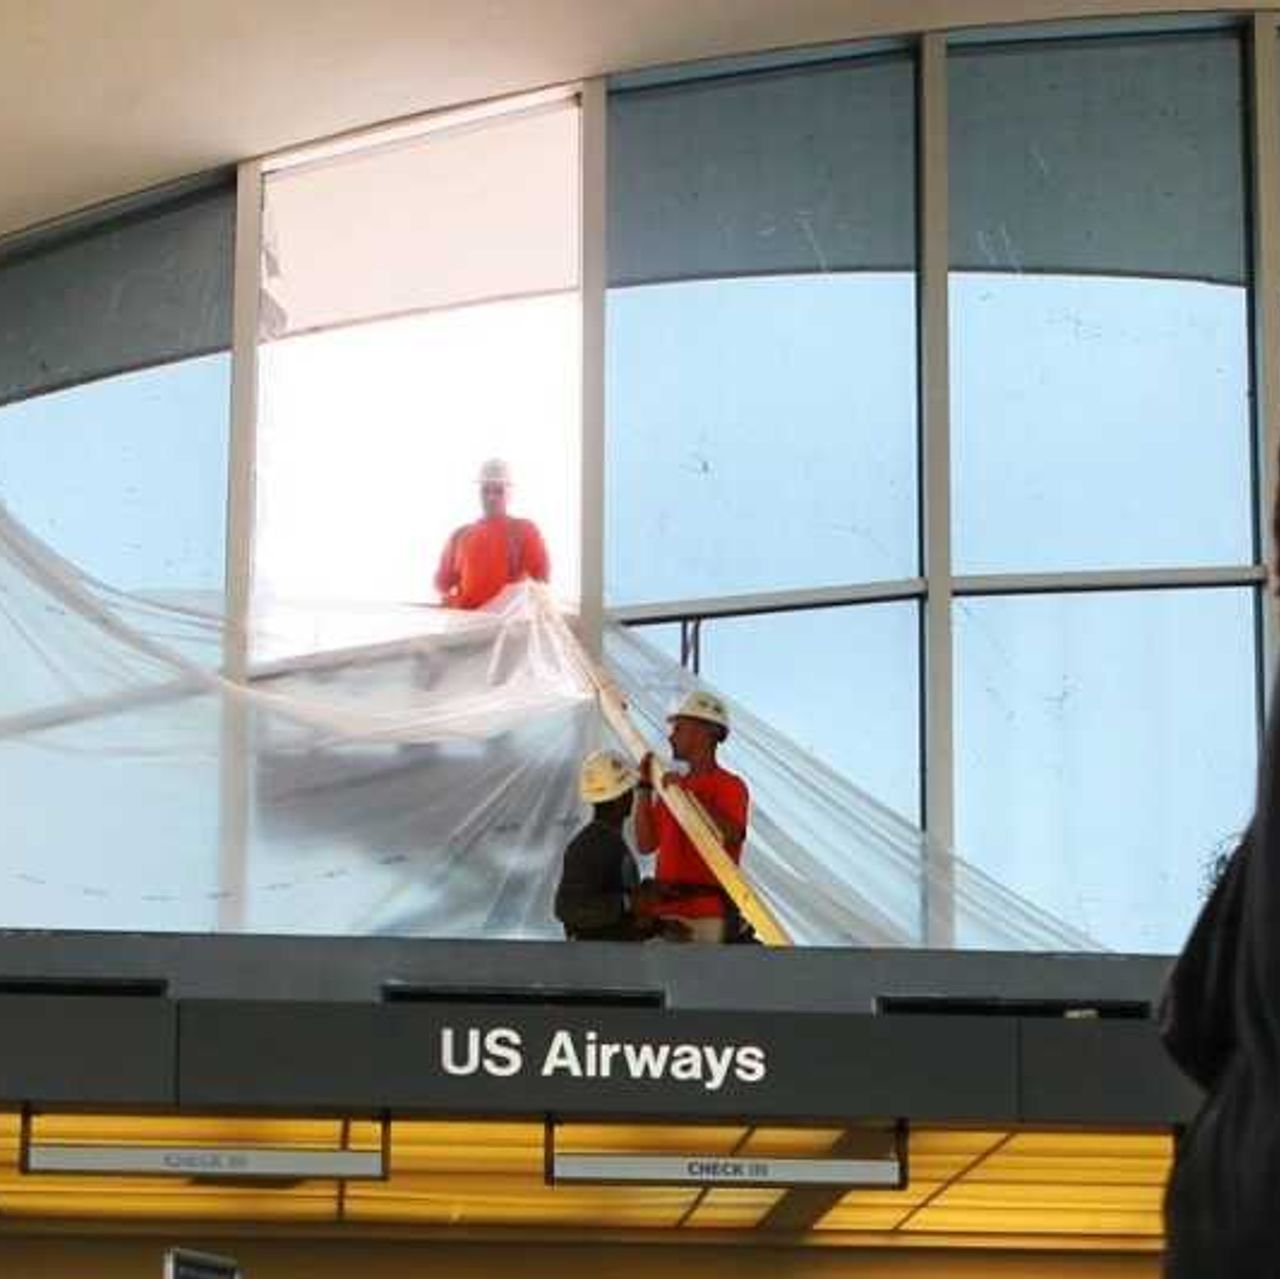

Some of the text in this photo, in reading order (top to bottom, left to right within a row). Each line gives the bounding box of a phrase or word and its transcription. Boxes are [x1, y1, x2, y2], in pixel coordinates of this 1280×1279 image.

[440, 1027, 767, 1090] US Airways
[687, 1161, 769, 1177] CHECK IN
